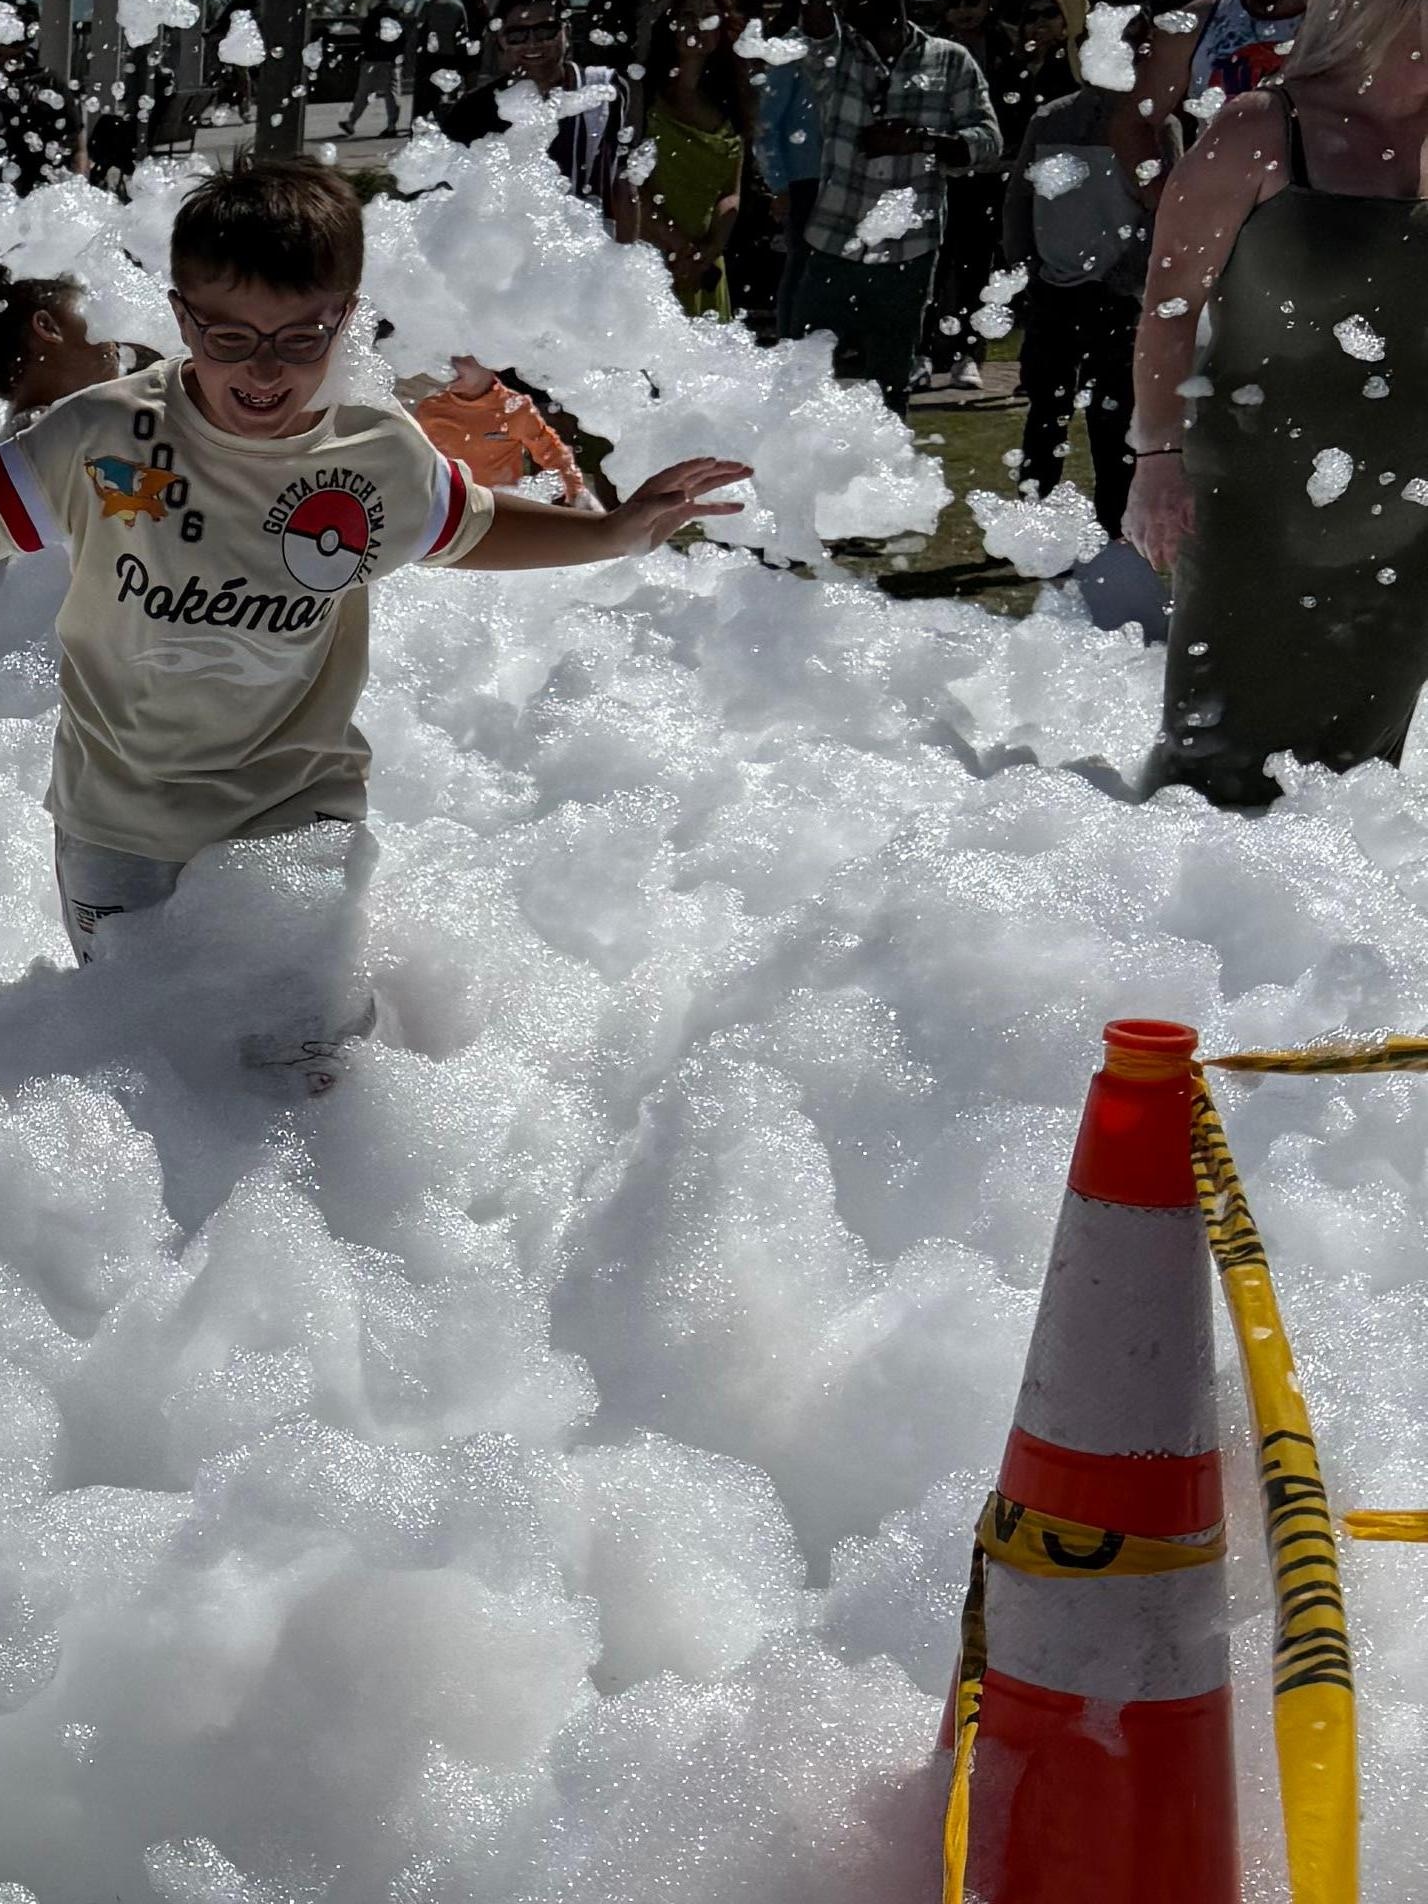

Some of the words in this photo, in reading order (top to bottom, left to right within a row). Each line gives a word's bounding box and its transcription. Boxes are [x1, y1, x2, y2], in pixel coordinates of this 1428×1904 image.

[262, 477, 314, 535] GOTTA
[315, 467, 377, 503] CATCH
[116, 552, 335, 634] Pokémon
